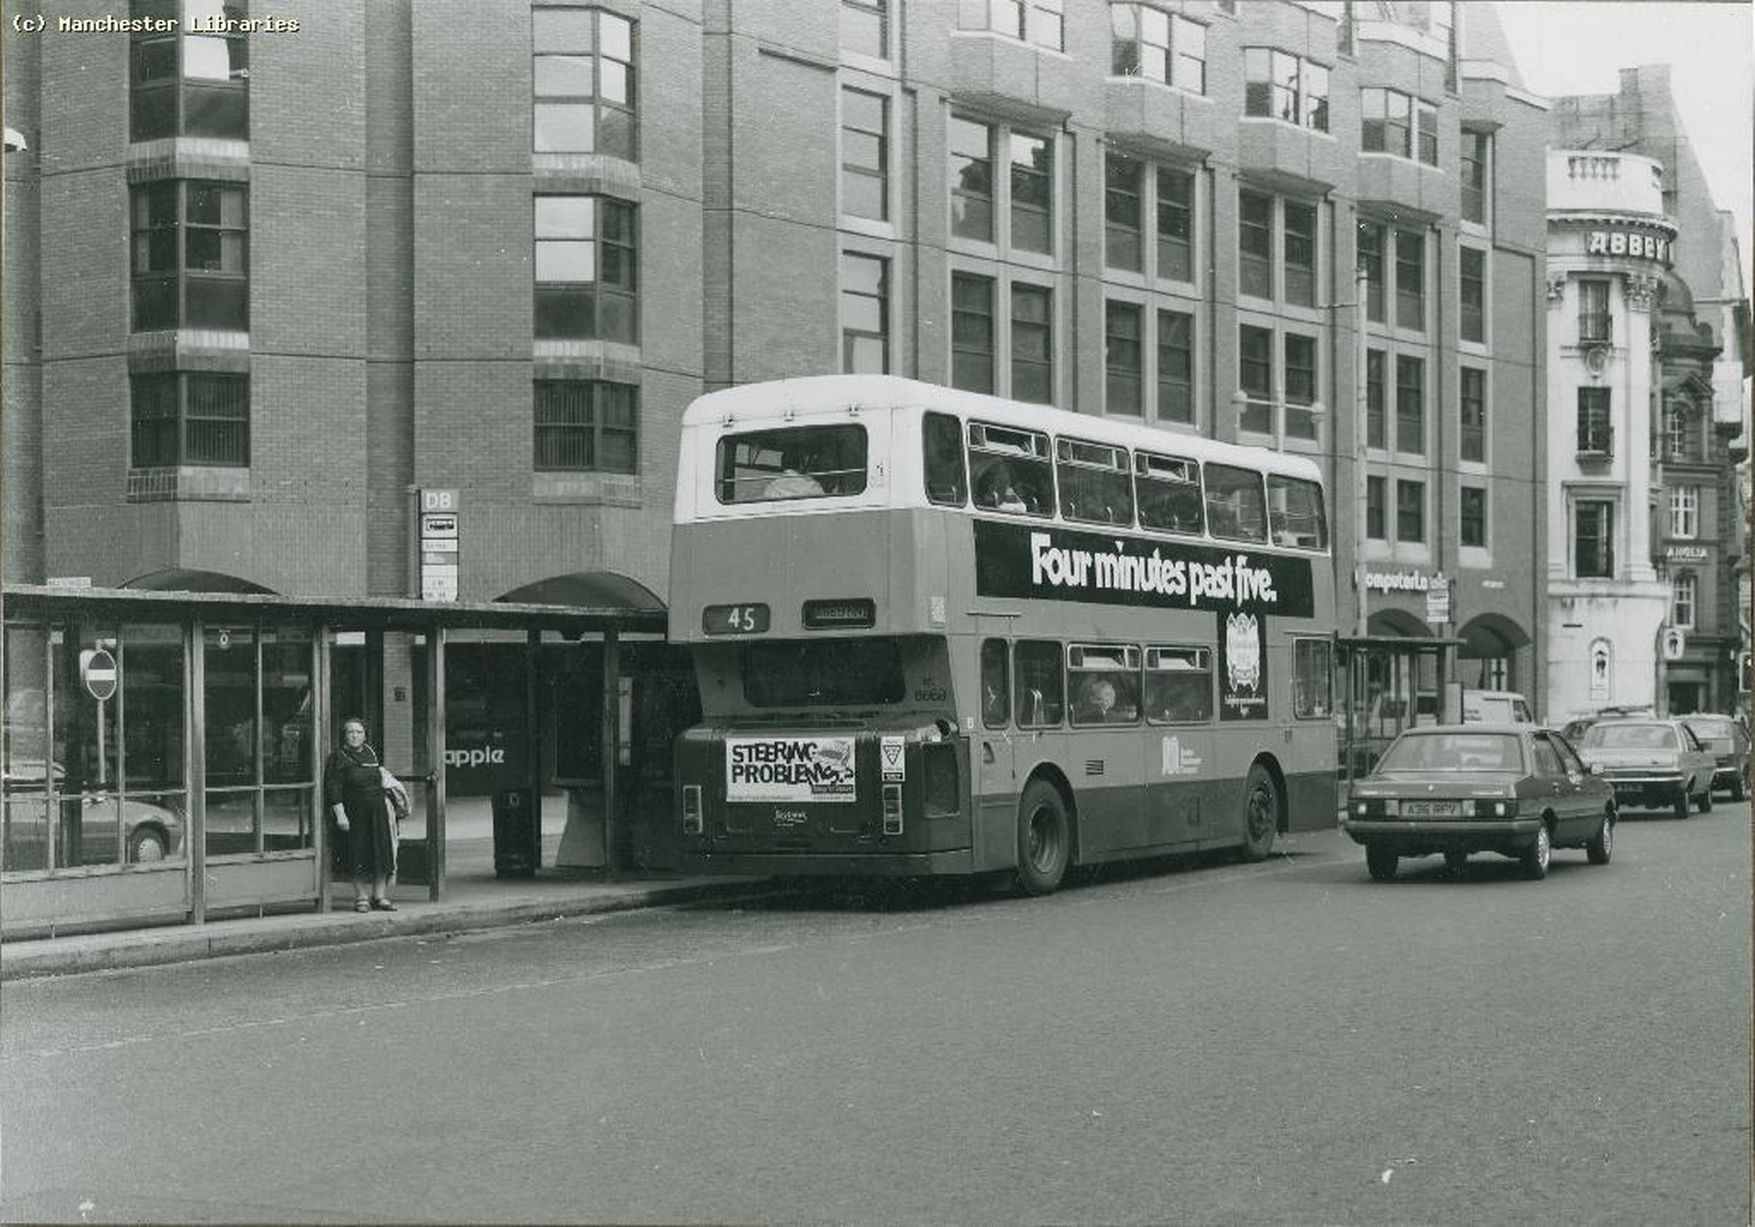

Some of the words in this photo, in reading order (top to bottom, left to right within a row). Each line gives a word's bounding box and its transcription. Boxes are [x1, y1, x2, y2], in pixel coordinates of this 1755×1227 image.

[426, 492, 452, 509] DB
[1030, 532, 1092, 587] Four
[1093, 540, 1187, 596] minutes
[1188, 556, 1235, 606] past
[1235, 555, 1278, 608] five.
[727, 607, 755, 631] 45
[443, 745, 505, 768] apple
[732, 741, 818, 764] STEERING
